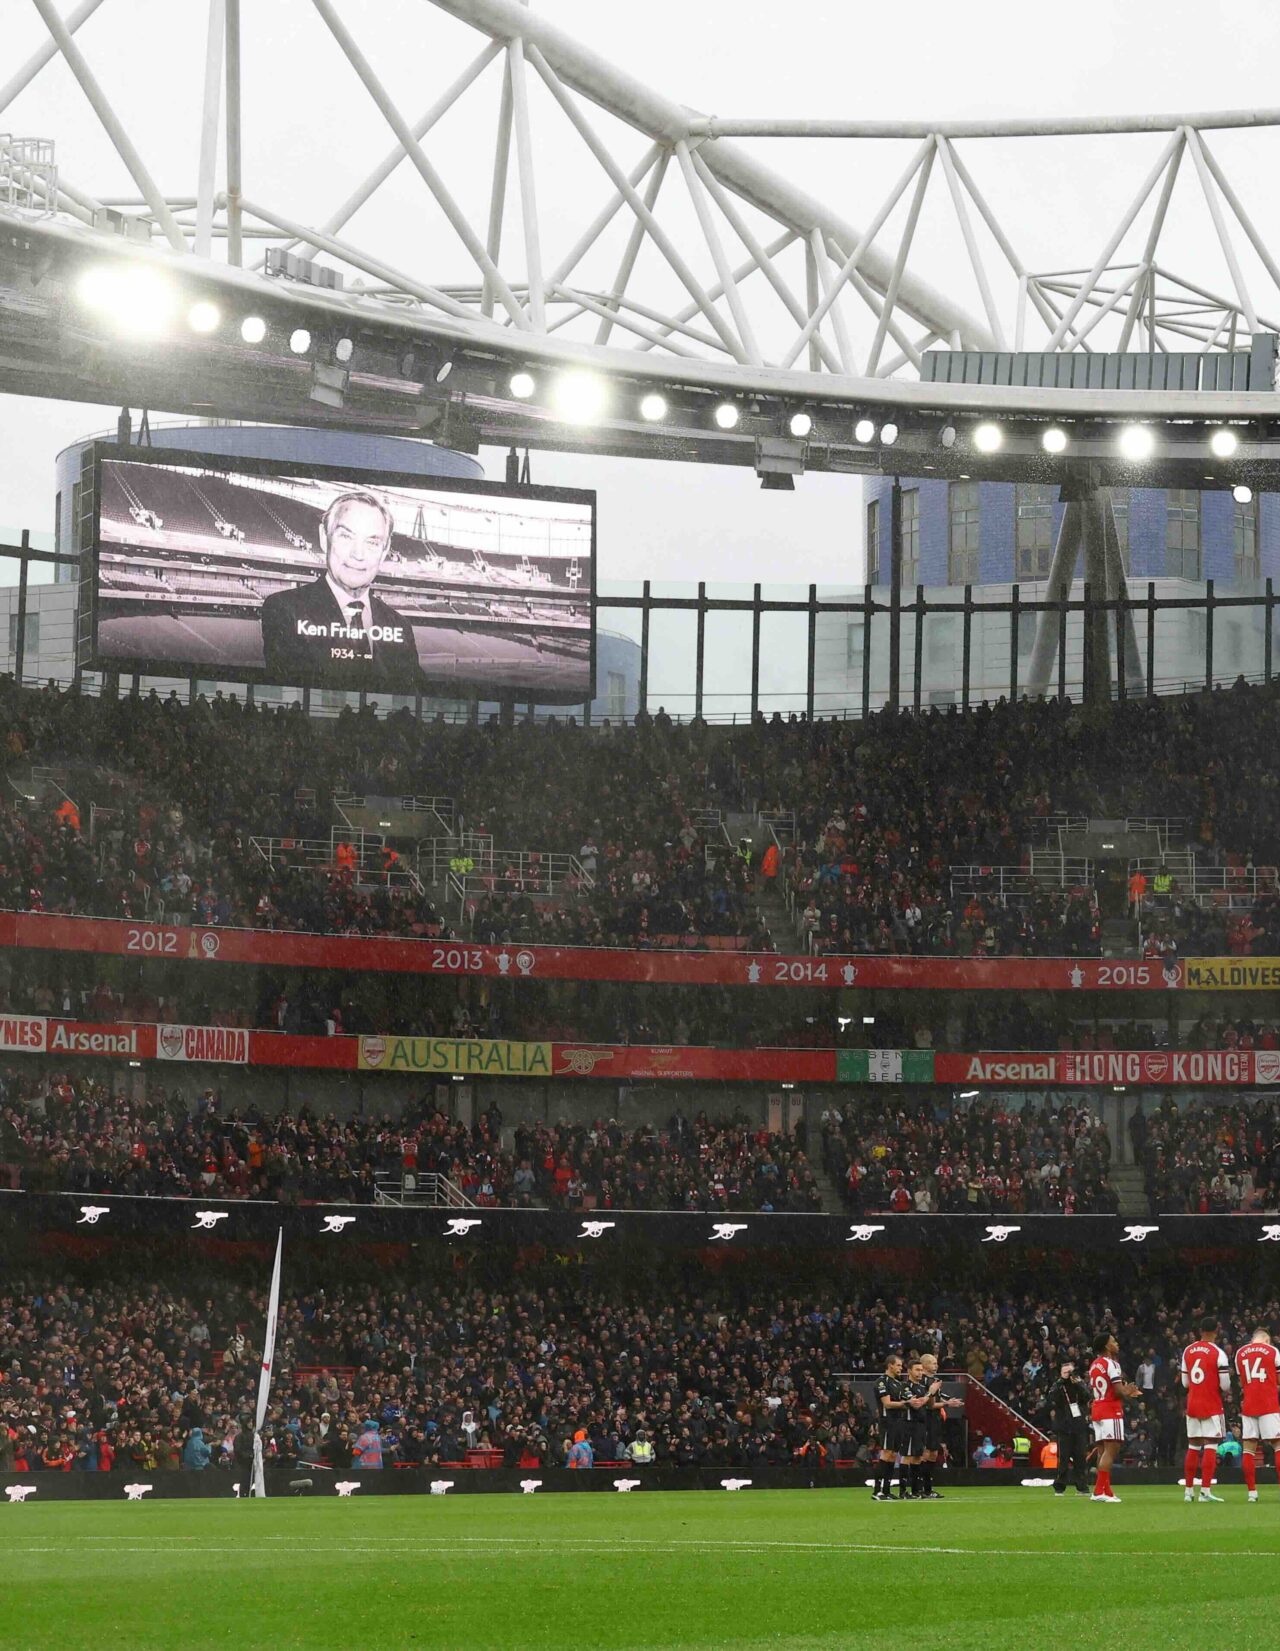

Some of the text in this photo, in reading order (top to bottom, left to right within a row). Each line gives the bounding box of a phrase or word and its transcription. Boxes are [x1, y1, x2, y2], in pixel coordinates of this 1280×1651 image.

[297, 619, 404, 643] Ken Friar OBE
[330, 647, 355, 660] 1934
[127, 929, 177, 953] 2012
[431, 949, 483, 970] 2013
[774, 961, 829, 981] 2014
[1097, 966, 1150, 985] 2015
[51, 1024, 137, 1053] Arsenal
[184, 1028, 246, 1062] CANADA
[389, 1039, 549, 1072] AUSTRALIA
[1075, 1053, 1239, 1081] HONG KONG
[965, 1056, 1056, 1081] Arsenal
[1189, 1346, 1211, 1355] GABRIEL
[1190, 1358, 1205, 1384] 6
[1241, 1357, 1267, 1384] 14
